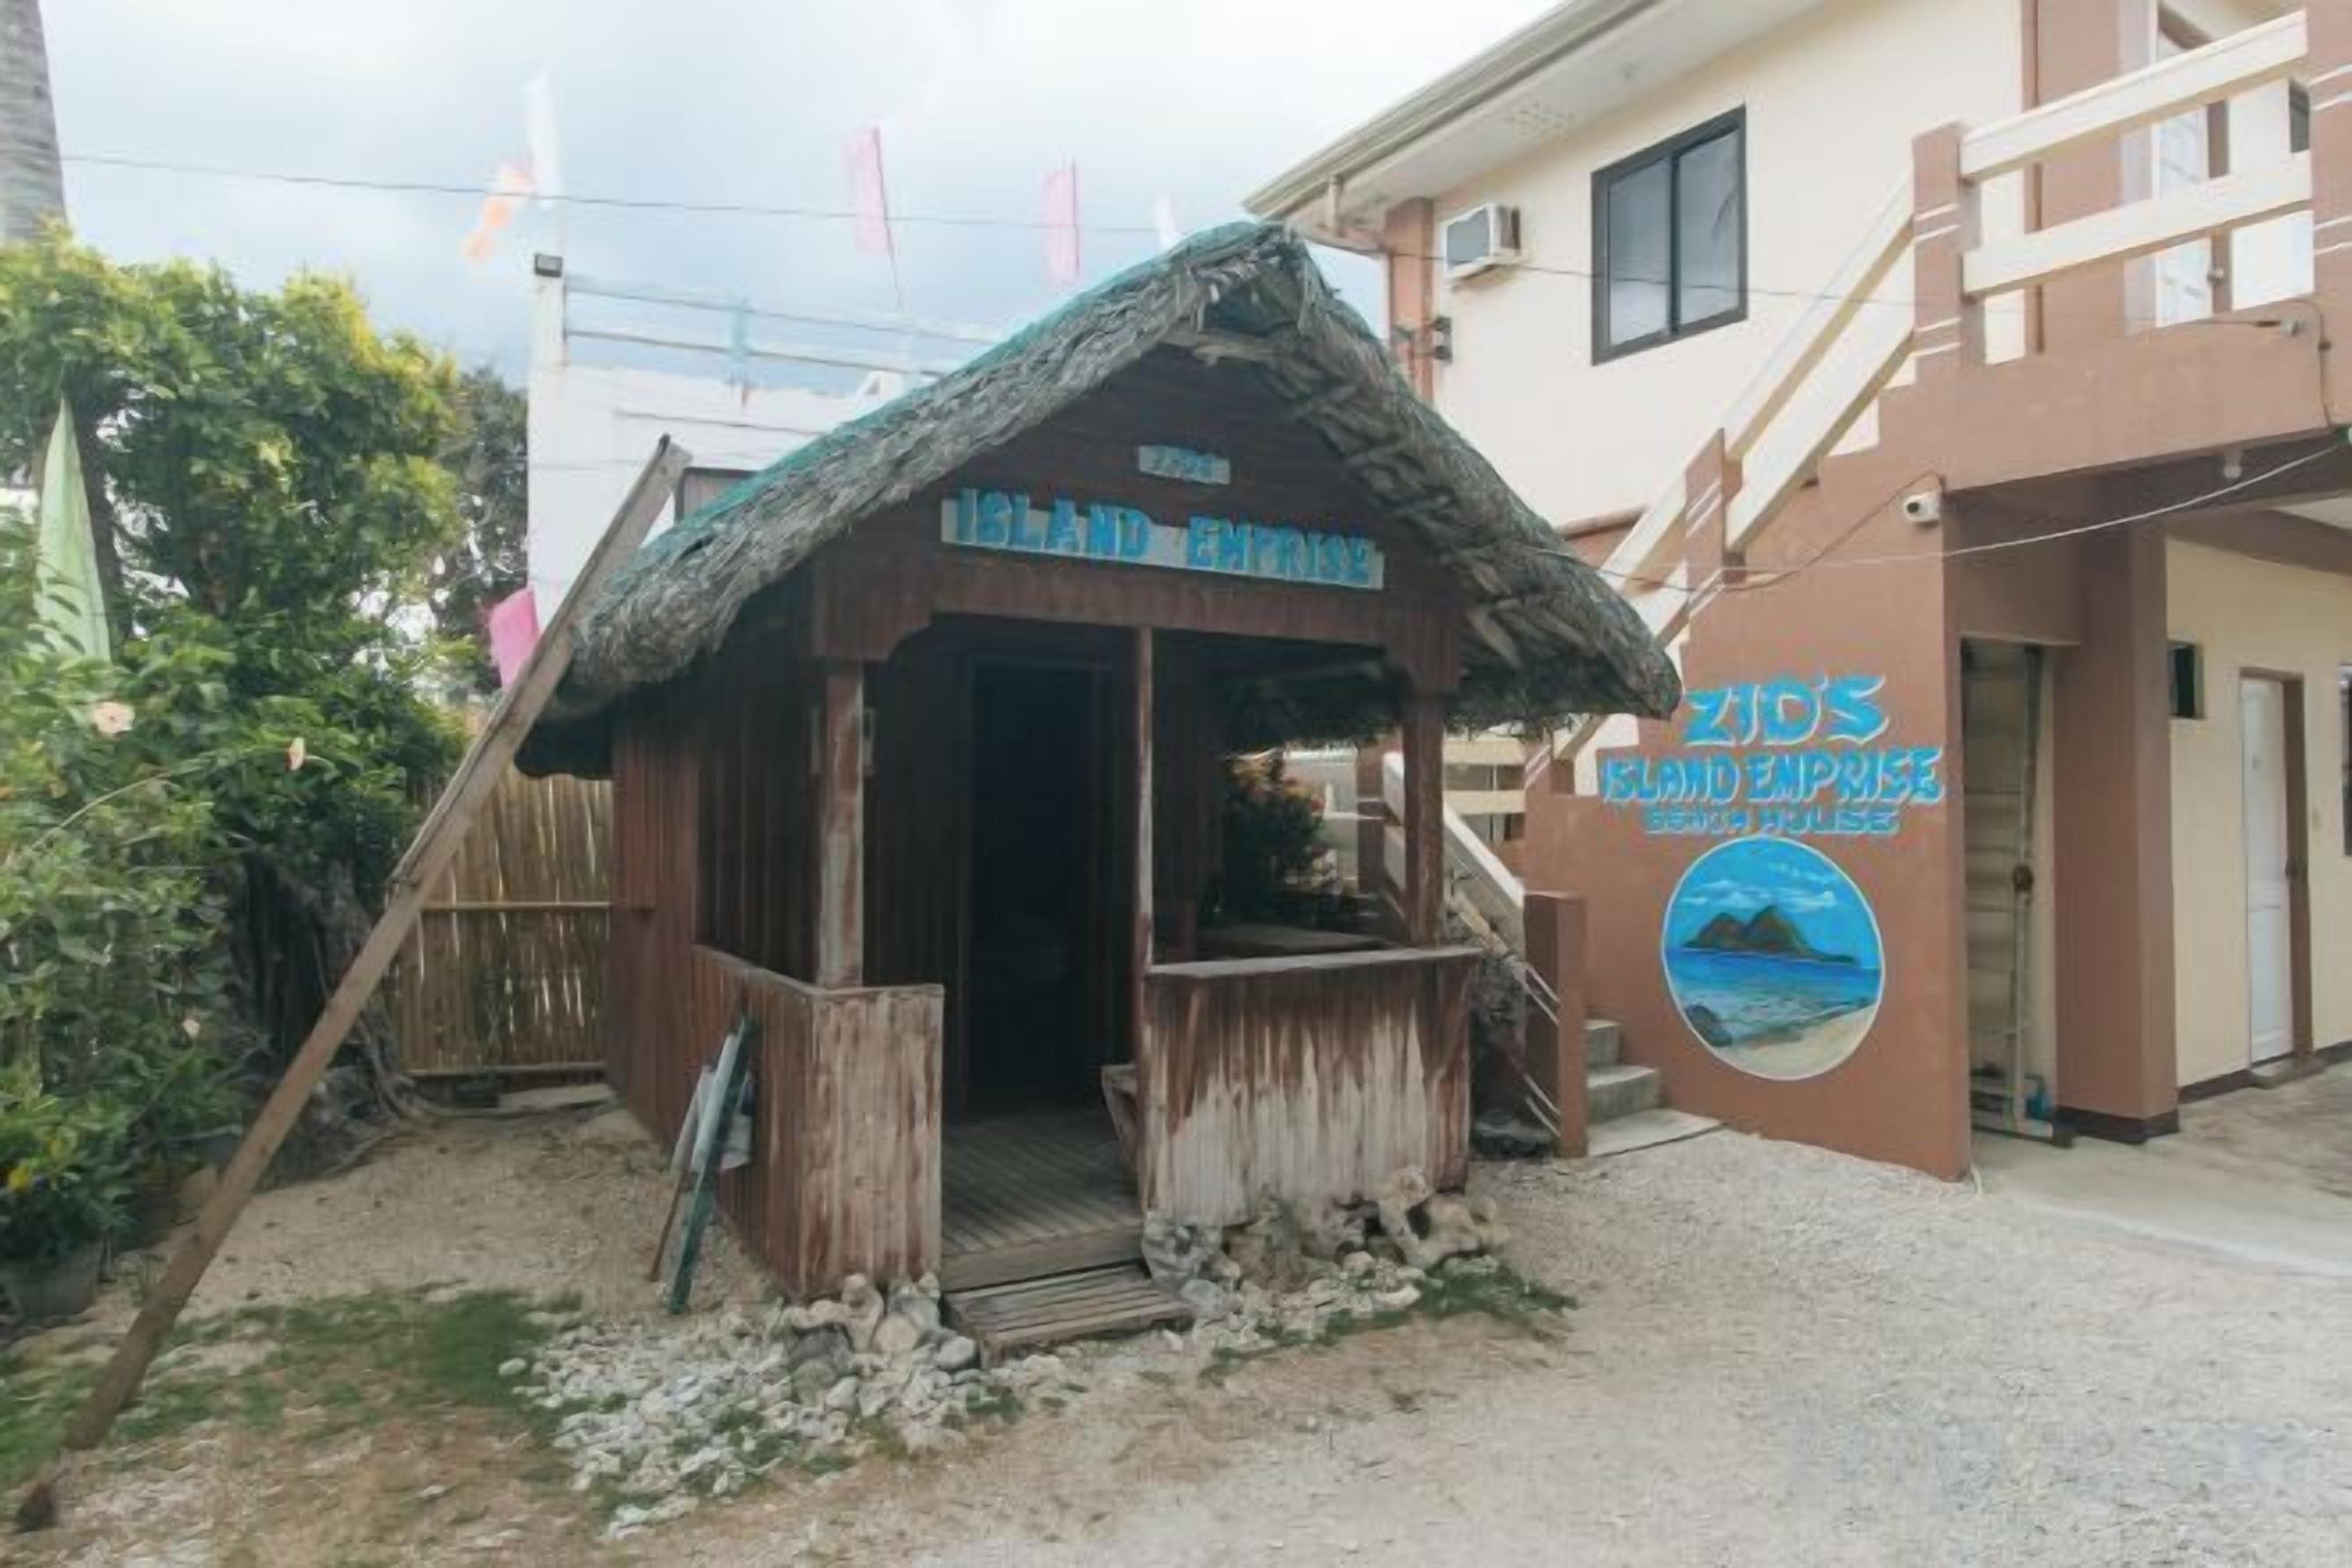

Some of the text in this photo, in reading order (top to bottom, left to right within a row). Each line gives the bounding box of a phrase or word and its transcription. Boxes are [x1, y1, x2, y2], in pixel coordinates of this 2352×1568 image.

[957, 489, 1372, 586] ISLAND EMPRISE
[1681, 673, 1890, 747] ZID'S
[1603, 745, 1946, 804] ISLAND EMPRISE
